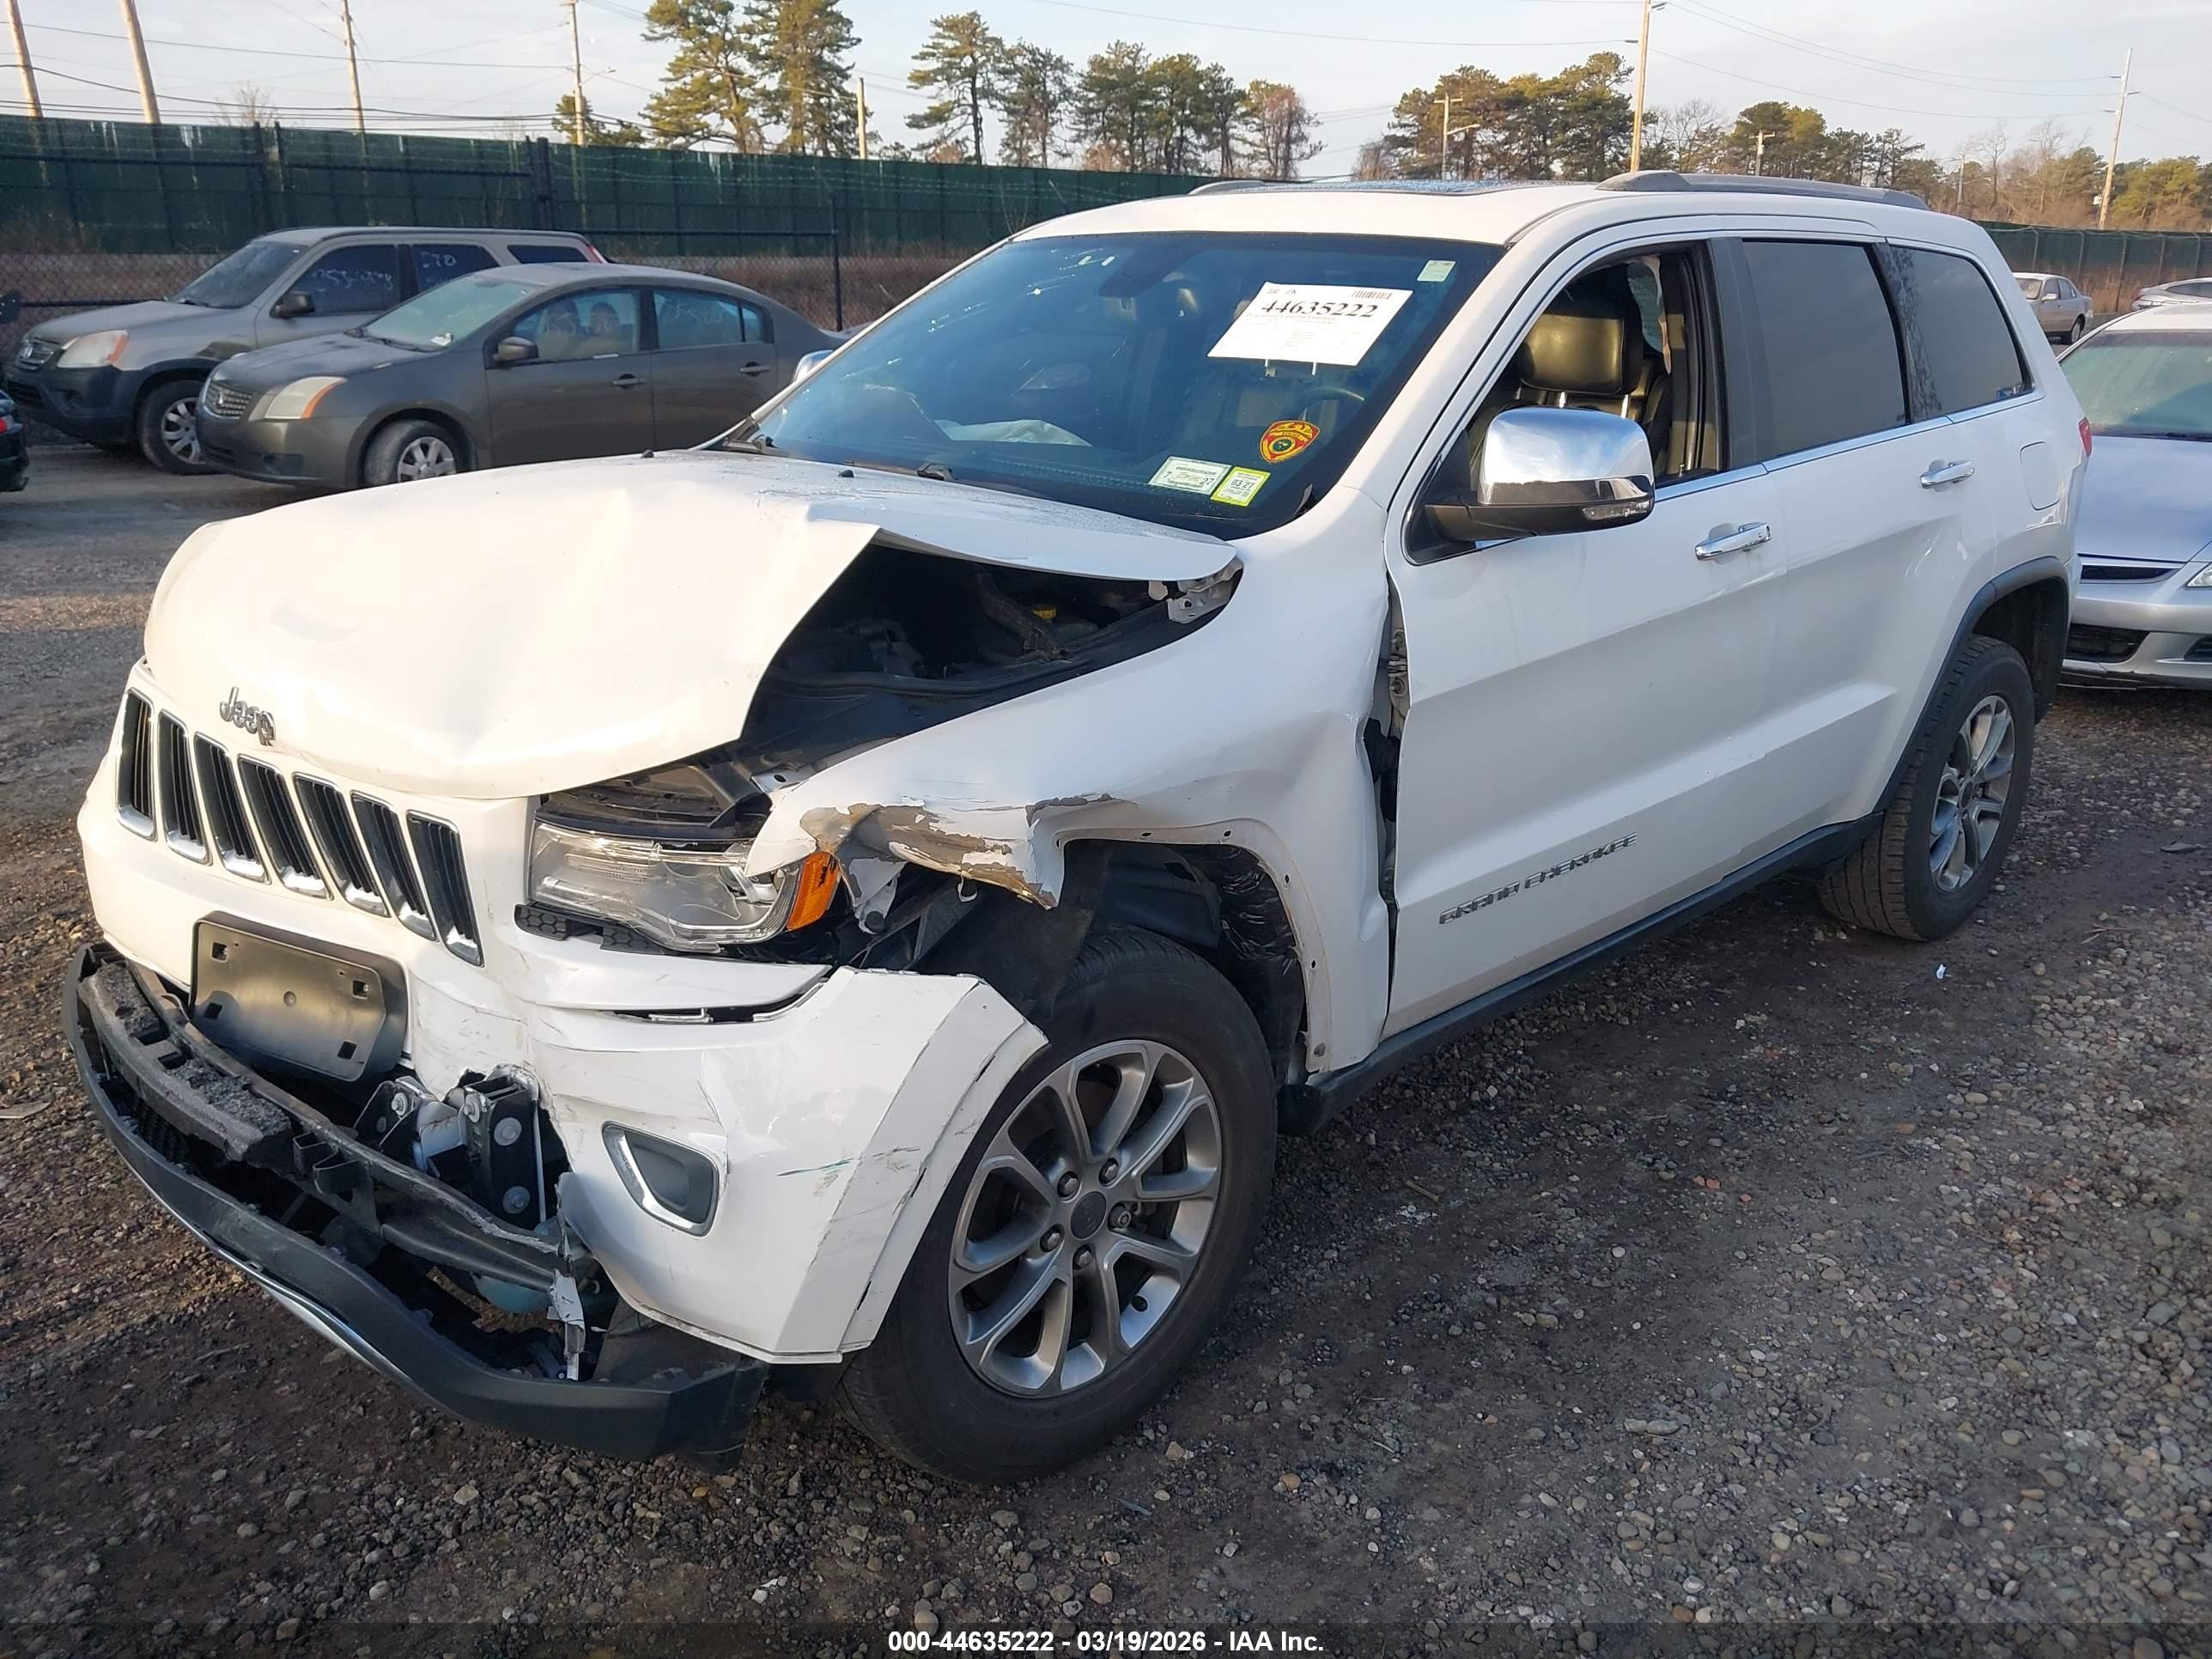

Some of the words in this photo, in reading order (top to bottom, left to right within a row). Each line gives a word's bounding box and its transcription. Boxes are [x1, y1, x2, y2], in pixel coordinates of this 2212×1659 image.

[1261, 300, 1378, 318] 44635222
[219, 686, 276, 746] Jeep
[1438, 881, 1521, 925] GRAND
[1524, 831, 1638, 889] CHEROKEE
